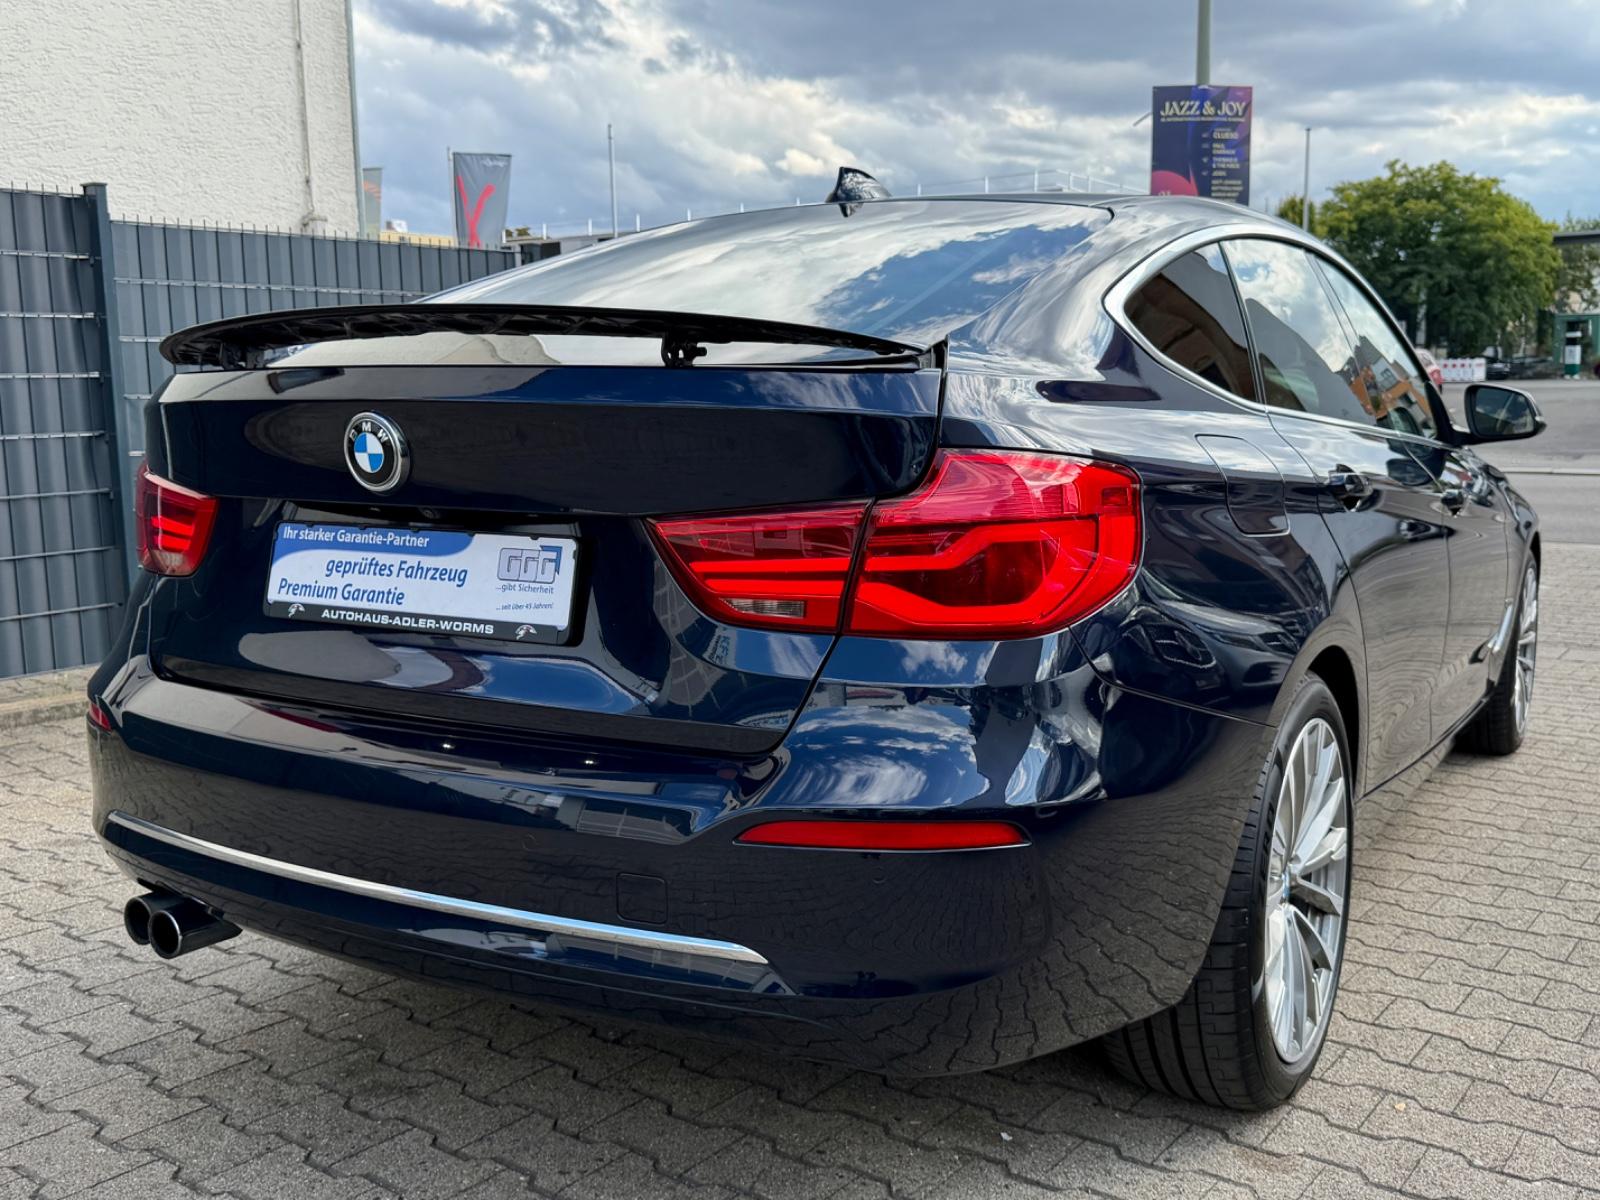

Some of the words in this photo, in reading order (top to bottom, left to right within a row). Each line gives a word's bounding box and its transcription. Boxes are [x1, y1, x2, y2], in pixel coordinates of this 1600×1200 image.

[1160, 101, 1200, 116] JAZZ
[1202, 100, 1215, 116] &
[1217, 101, 1246, 116] JOY
[349, 421, 389, 443] BMW
[283, 526, 298, 540] Ihr
[299, 528, 336, 543] starker
[337, 530, 430, 549] Garantie-Partner
[325, 557, 394, 579] geprüftes
[397, 560, 469, 587] Fahrzeug
[278, 578, 338, 601] Premium
[341, 583, 406, 606] Garantie
[518, 584, 554, 594] Sicherheit
[321, 608, 495, 635] AUTOHAUS-ADLER-WORMS
